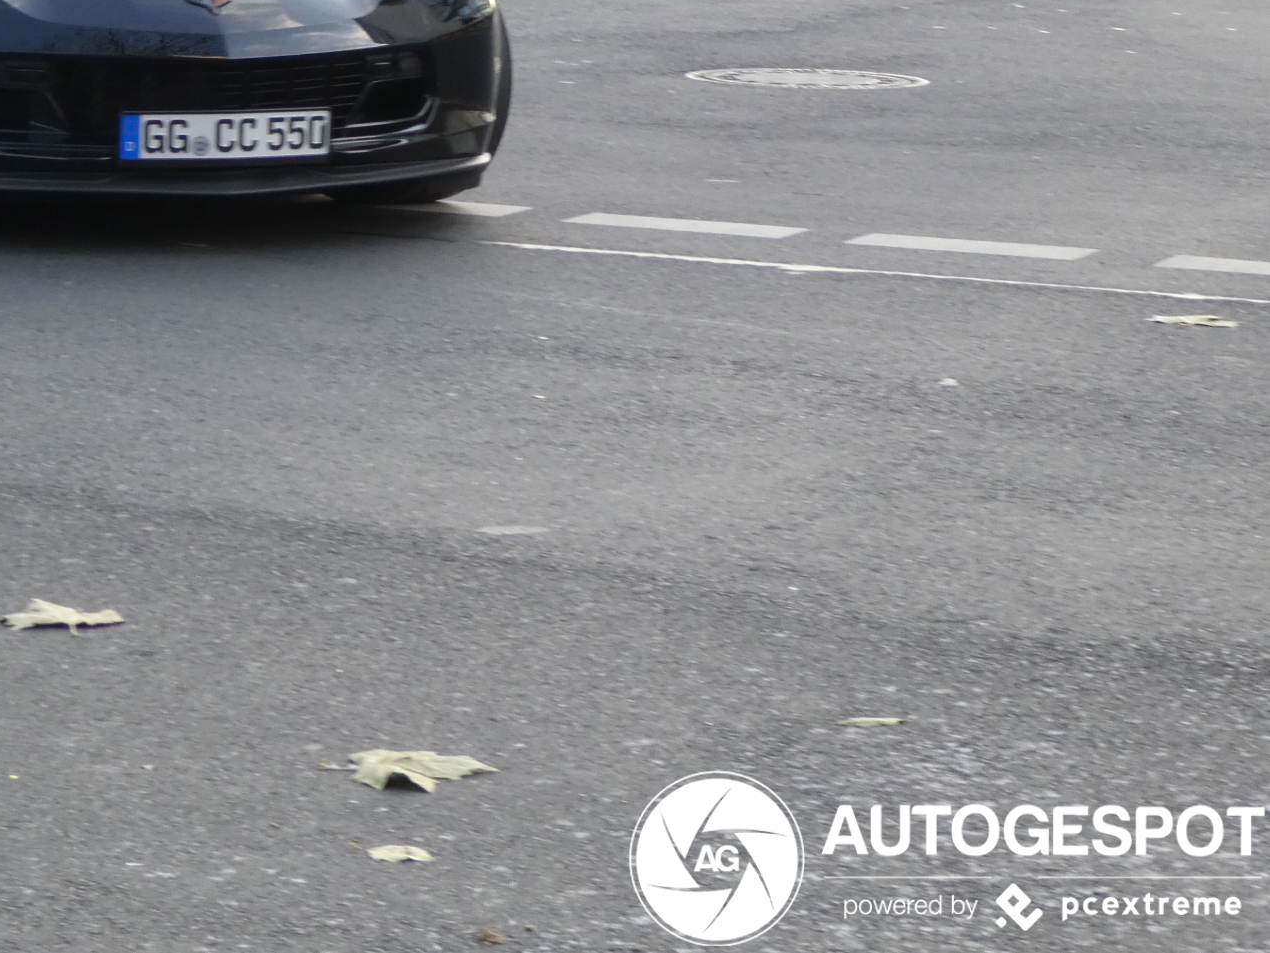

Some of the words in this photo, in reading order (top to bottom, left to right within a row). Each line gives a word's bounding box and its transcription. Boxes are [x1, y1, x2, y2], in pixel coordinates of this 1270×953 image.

[144, 119, 189, 153] GG
[215, 118, 257, 152] CC
[267, 116, 325, 150] 550
